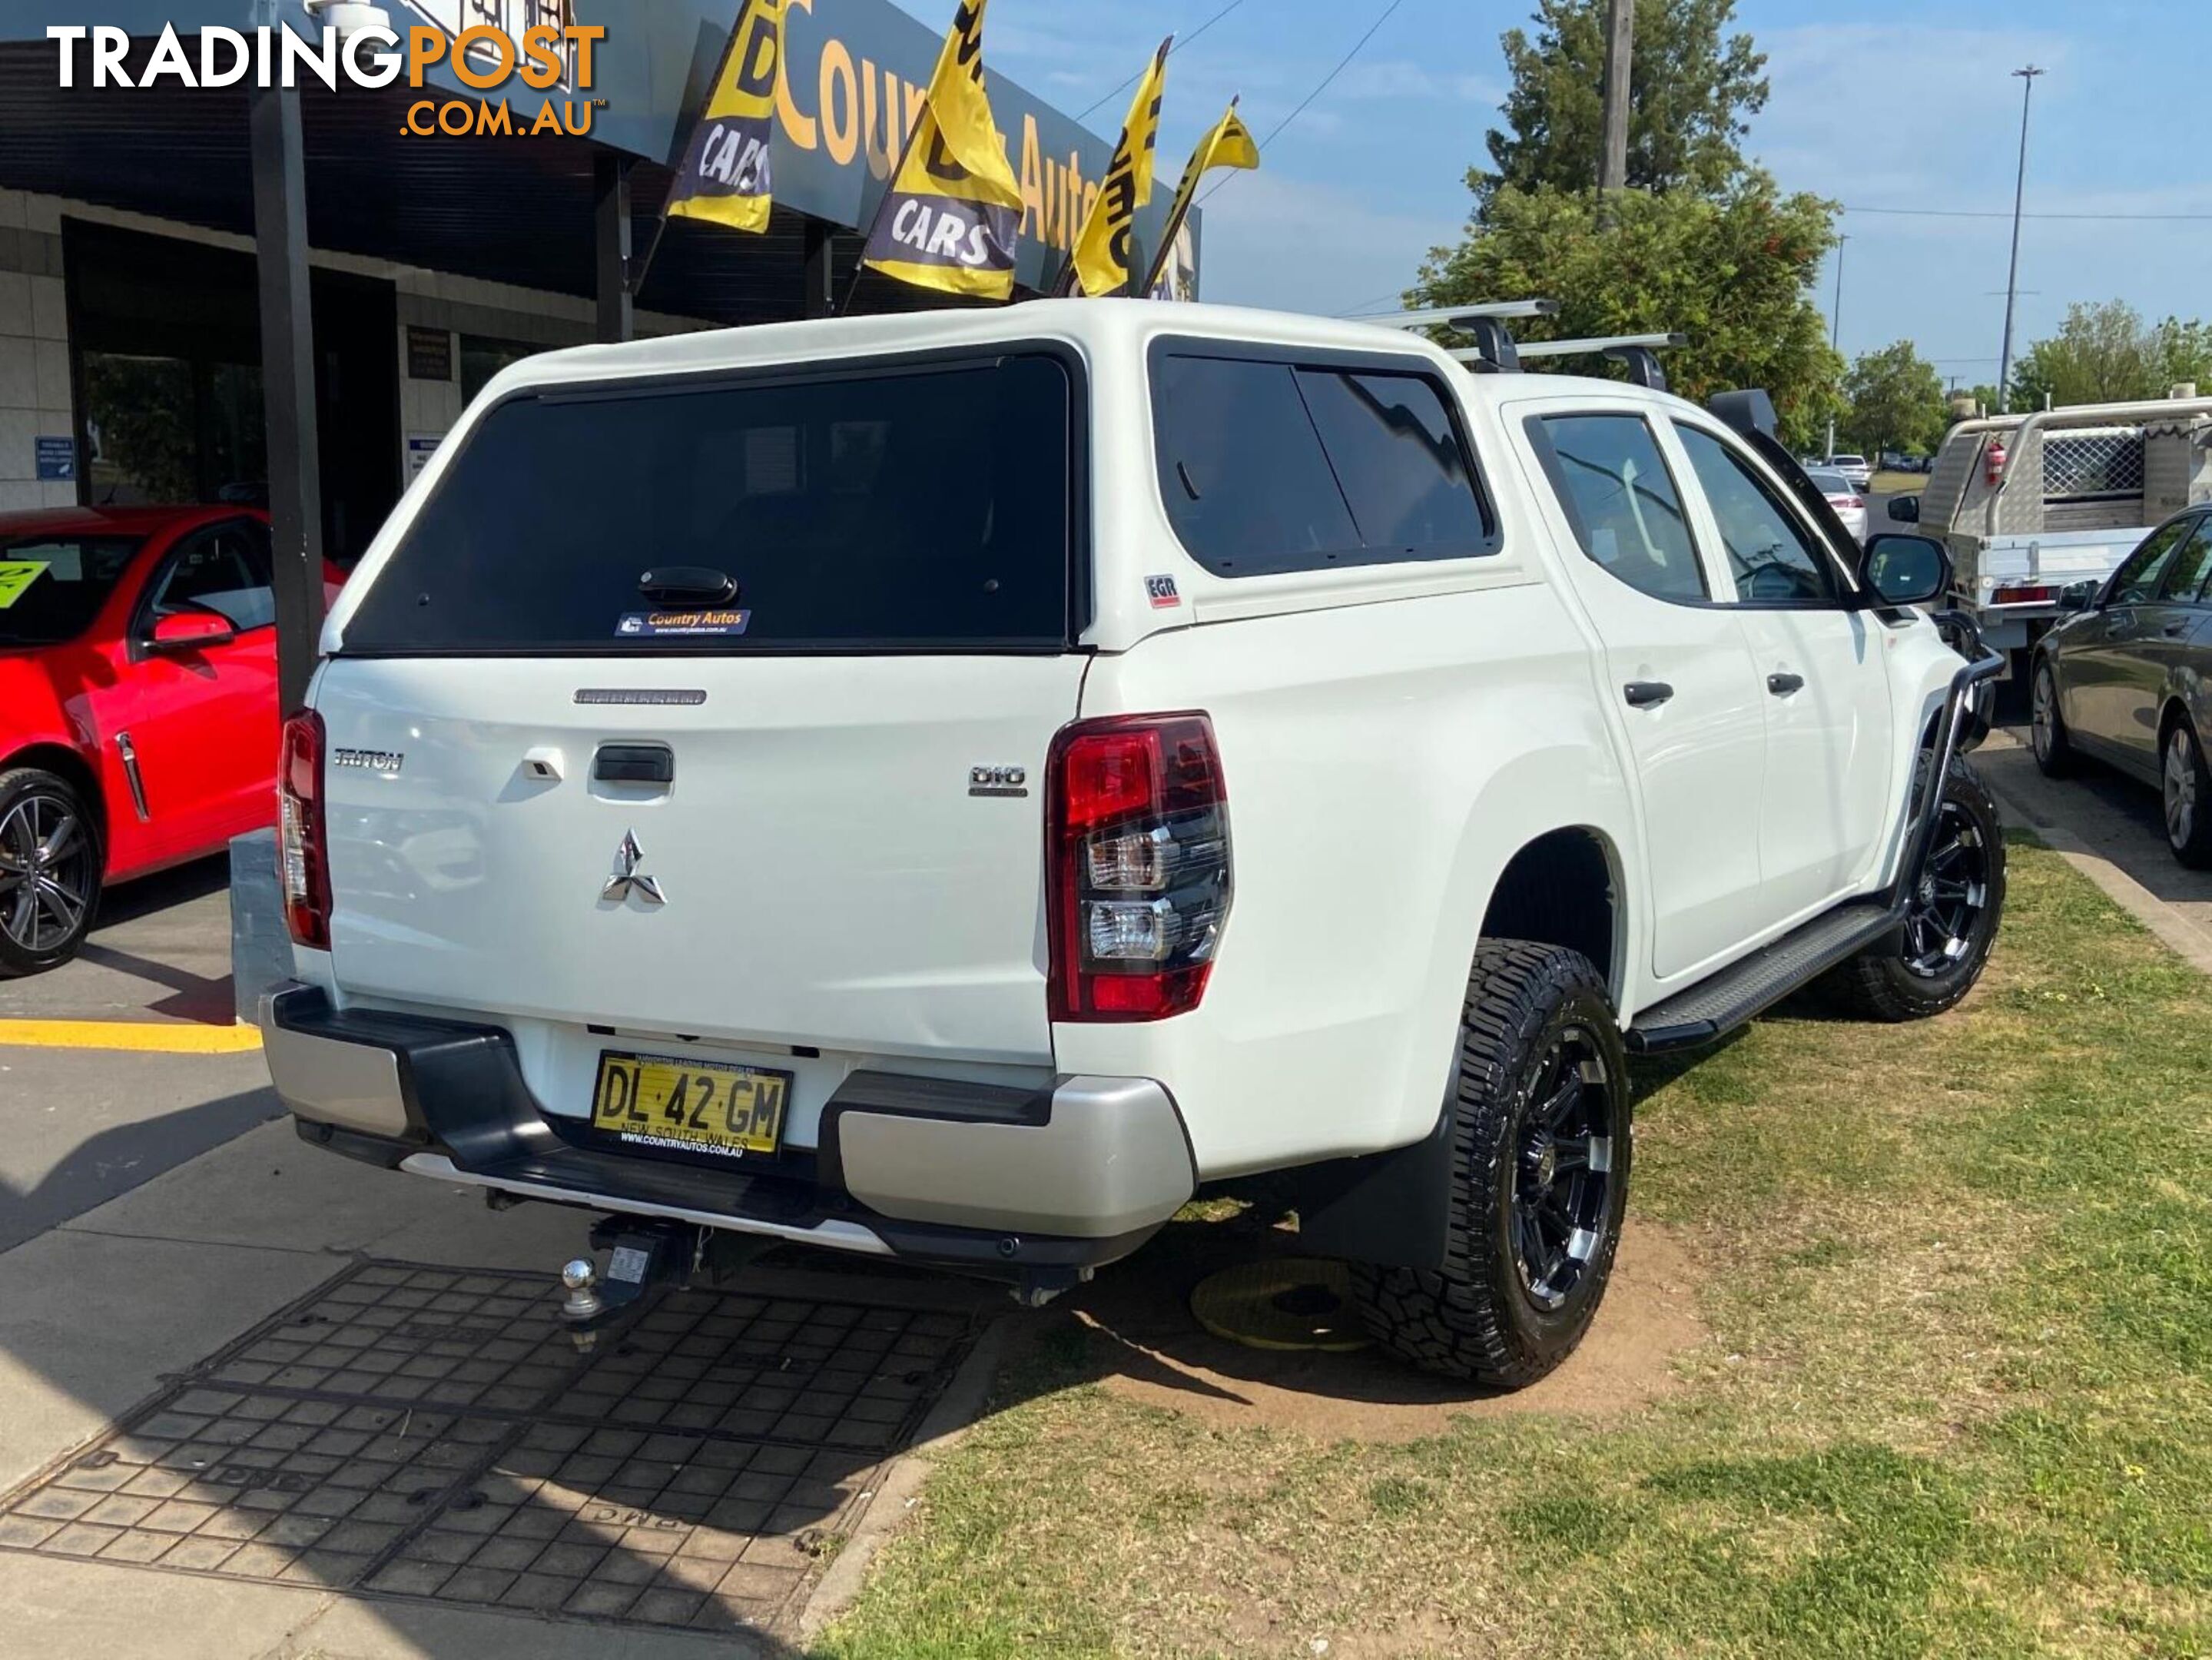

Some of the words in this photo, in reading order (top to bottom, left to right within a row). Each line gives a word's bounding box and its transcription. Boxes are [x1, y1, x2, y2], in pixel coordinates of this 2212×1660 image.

[699, 124, 771, 191] CARS
[1017, 113, 1103, 251] Auto
[892, 198, 990, 265] CARS
[1148, 577, 1178, 598] EGR
[648, 613, 701, 627] Country
[702, 612, 741, 625] Autos
[602, 1065, 649, 1122] DL
[664, 1073, 715, 1130] 42
[725, 1080, 780, 1138] GM
[621, 1122, 650, 1136] NEW
[655, 1127, 700, 1144] SOUTH
[705, 1132, 750, 1150] WALES
[621, 1132, 744, 1158] WWW.COUNTRYAUTOS.COM.AU
